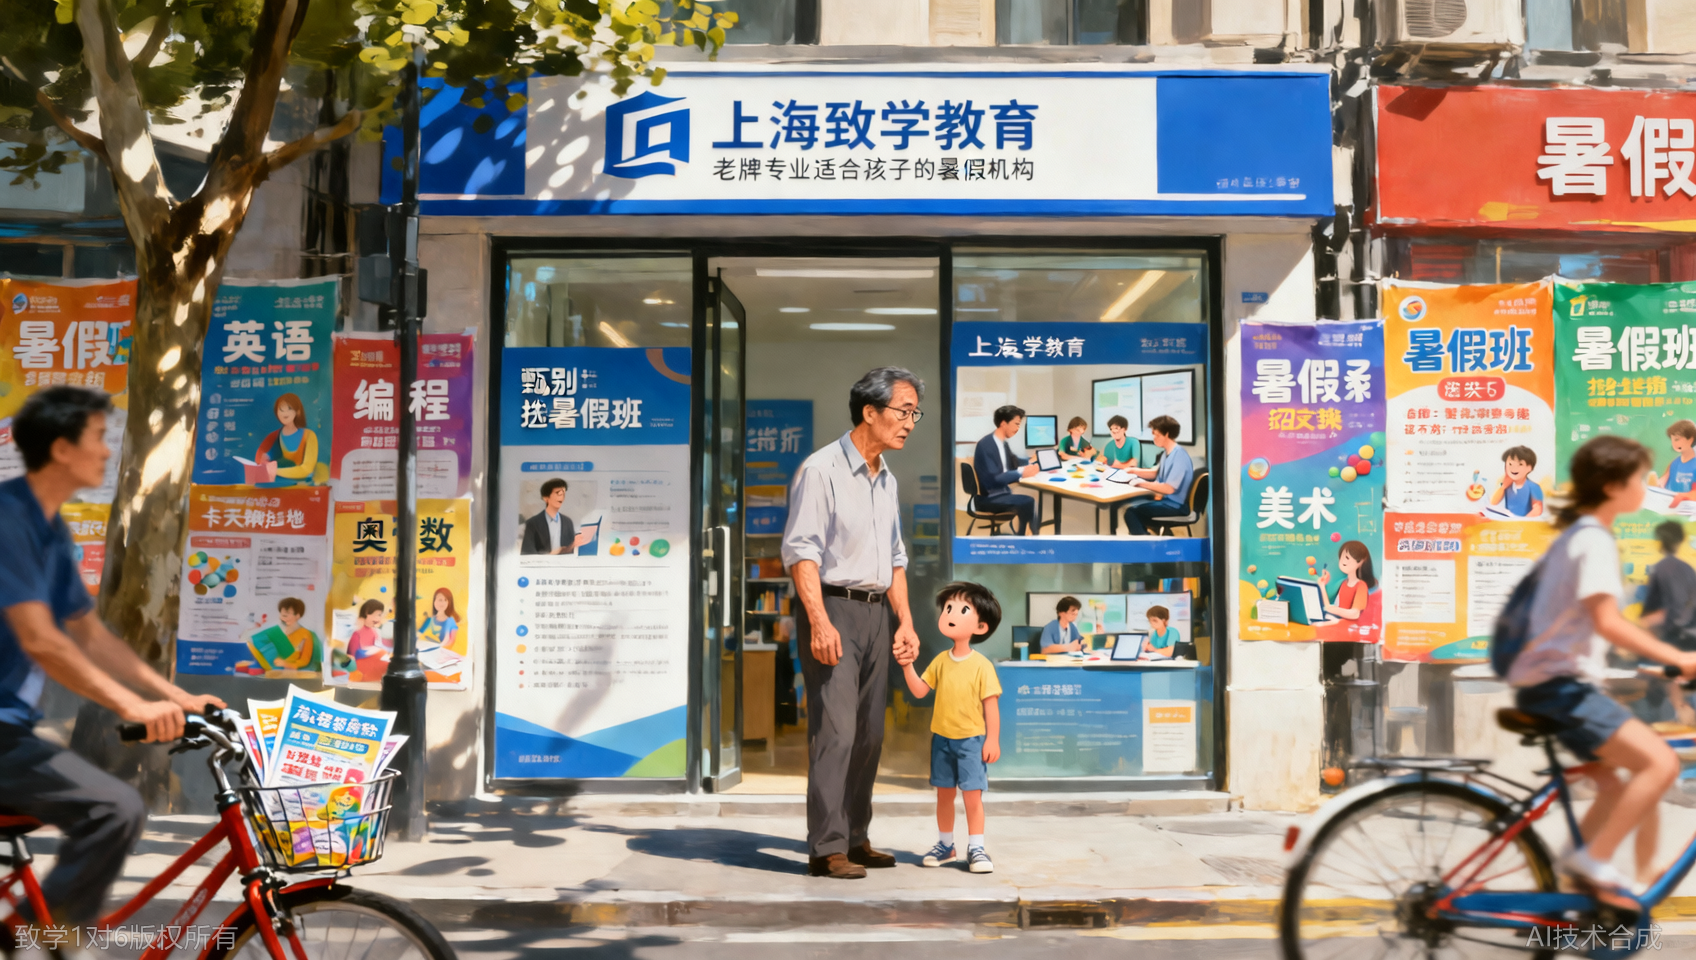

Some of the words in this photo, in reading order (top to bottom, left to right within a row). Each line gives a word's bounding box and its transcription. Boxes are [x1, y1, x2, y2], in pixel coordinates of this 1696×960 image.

[712, 99, 1039, 151] 上海致学教育
[712, 156, 1035, 182] 老牌专业适合孩子的暑假机构
[1537, 115, 1696, 197] 暑假
[222, 320, 314, 363] 英语
[1403, 324, 1535, 374] 暑假班
[1572, 324, 1696, 372] 暑假班
[353, 378, 450, 421] 编程
[1256, 486, 1337, 529] 美术
